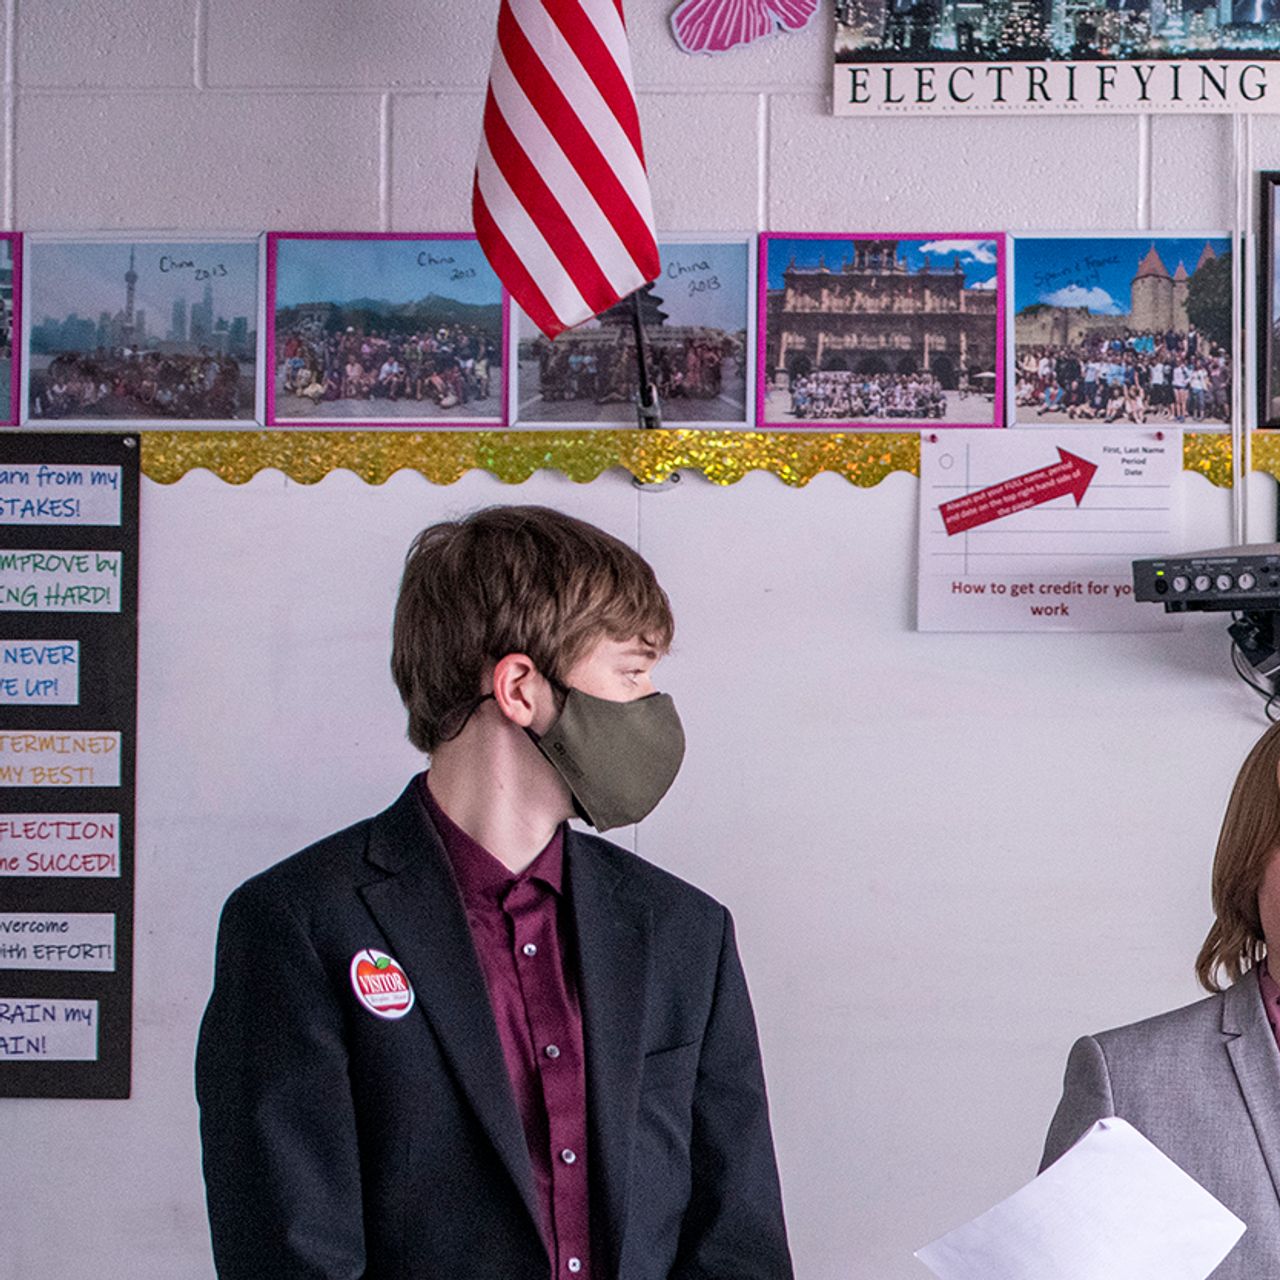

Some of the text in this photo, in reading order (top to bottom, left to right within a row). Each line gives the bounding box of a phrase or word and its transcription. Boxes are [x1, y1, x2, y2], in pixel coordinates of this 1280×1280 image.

[848, 65, 1267, 103] ELECTRIFYING
[159, 256, 195, 273] China
[417, 251, 455, 267] China
[194, 264, 228, 281] 2013
[452, 267, 477, 281] 2013
[667, 261, 710, 279] China
[688, 275, 721, 297] 2013
[36, 465, 83, 487] from
[91, 471, 118, 489] my
[96, 553, 118, 577] by
[44, 582, 111, 606] HARD!
[952, 580, 1134, 597] How to get credit for yo
[1030, 603, 1069, 616] work
[4, 645, 76, 665] NEVER
[25, 678, 59, 696] UP!
[30, 765, 95, 784] BEST!
[26, 852, 116, 872] SUCCED!
[0, 919, 69, 933] vercome
[33, 942, 112, 961] EFFORT!
[359, 972, 406, 994] VISITOR
[65, 1007, 92, 1026] my
